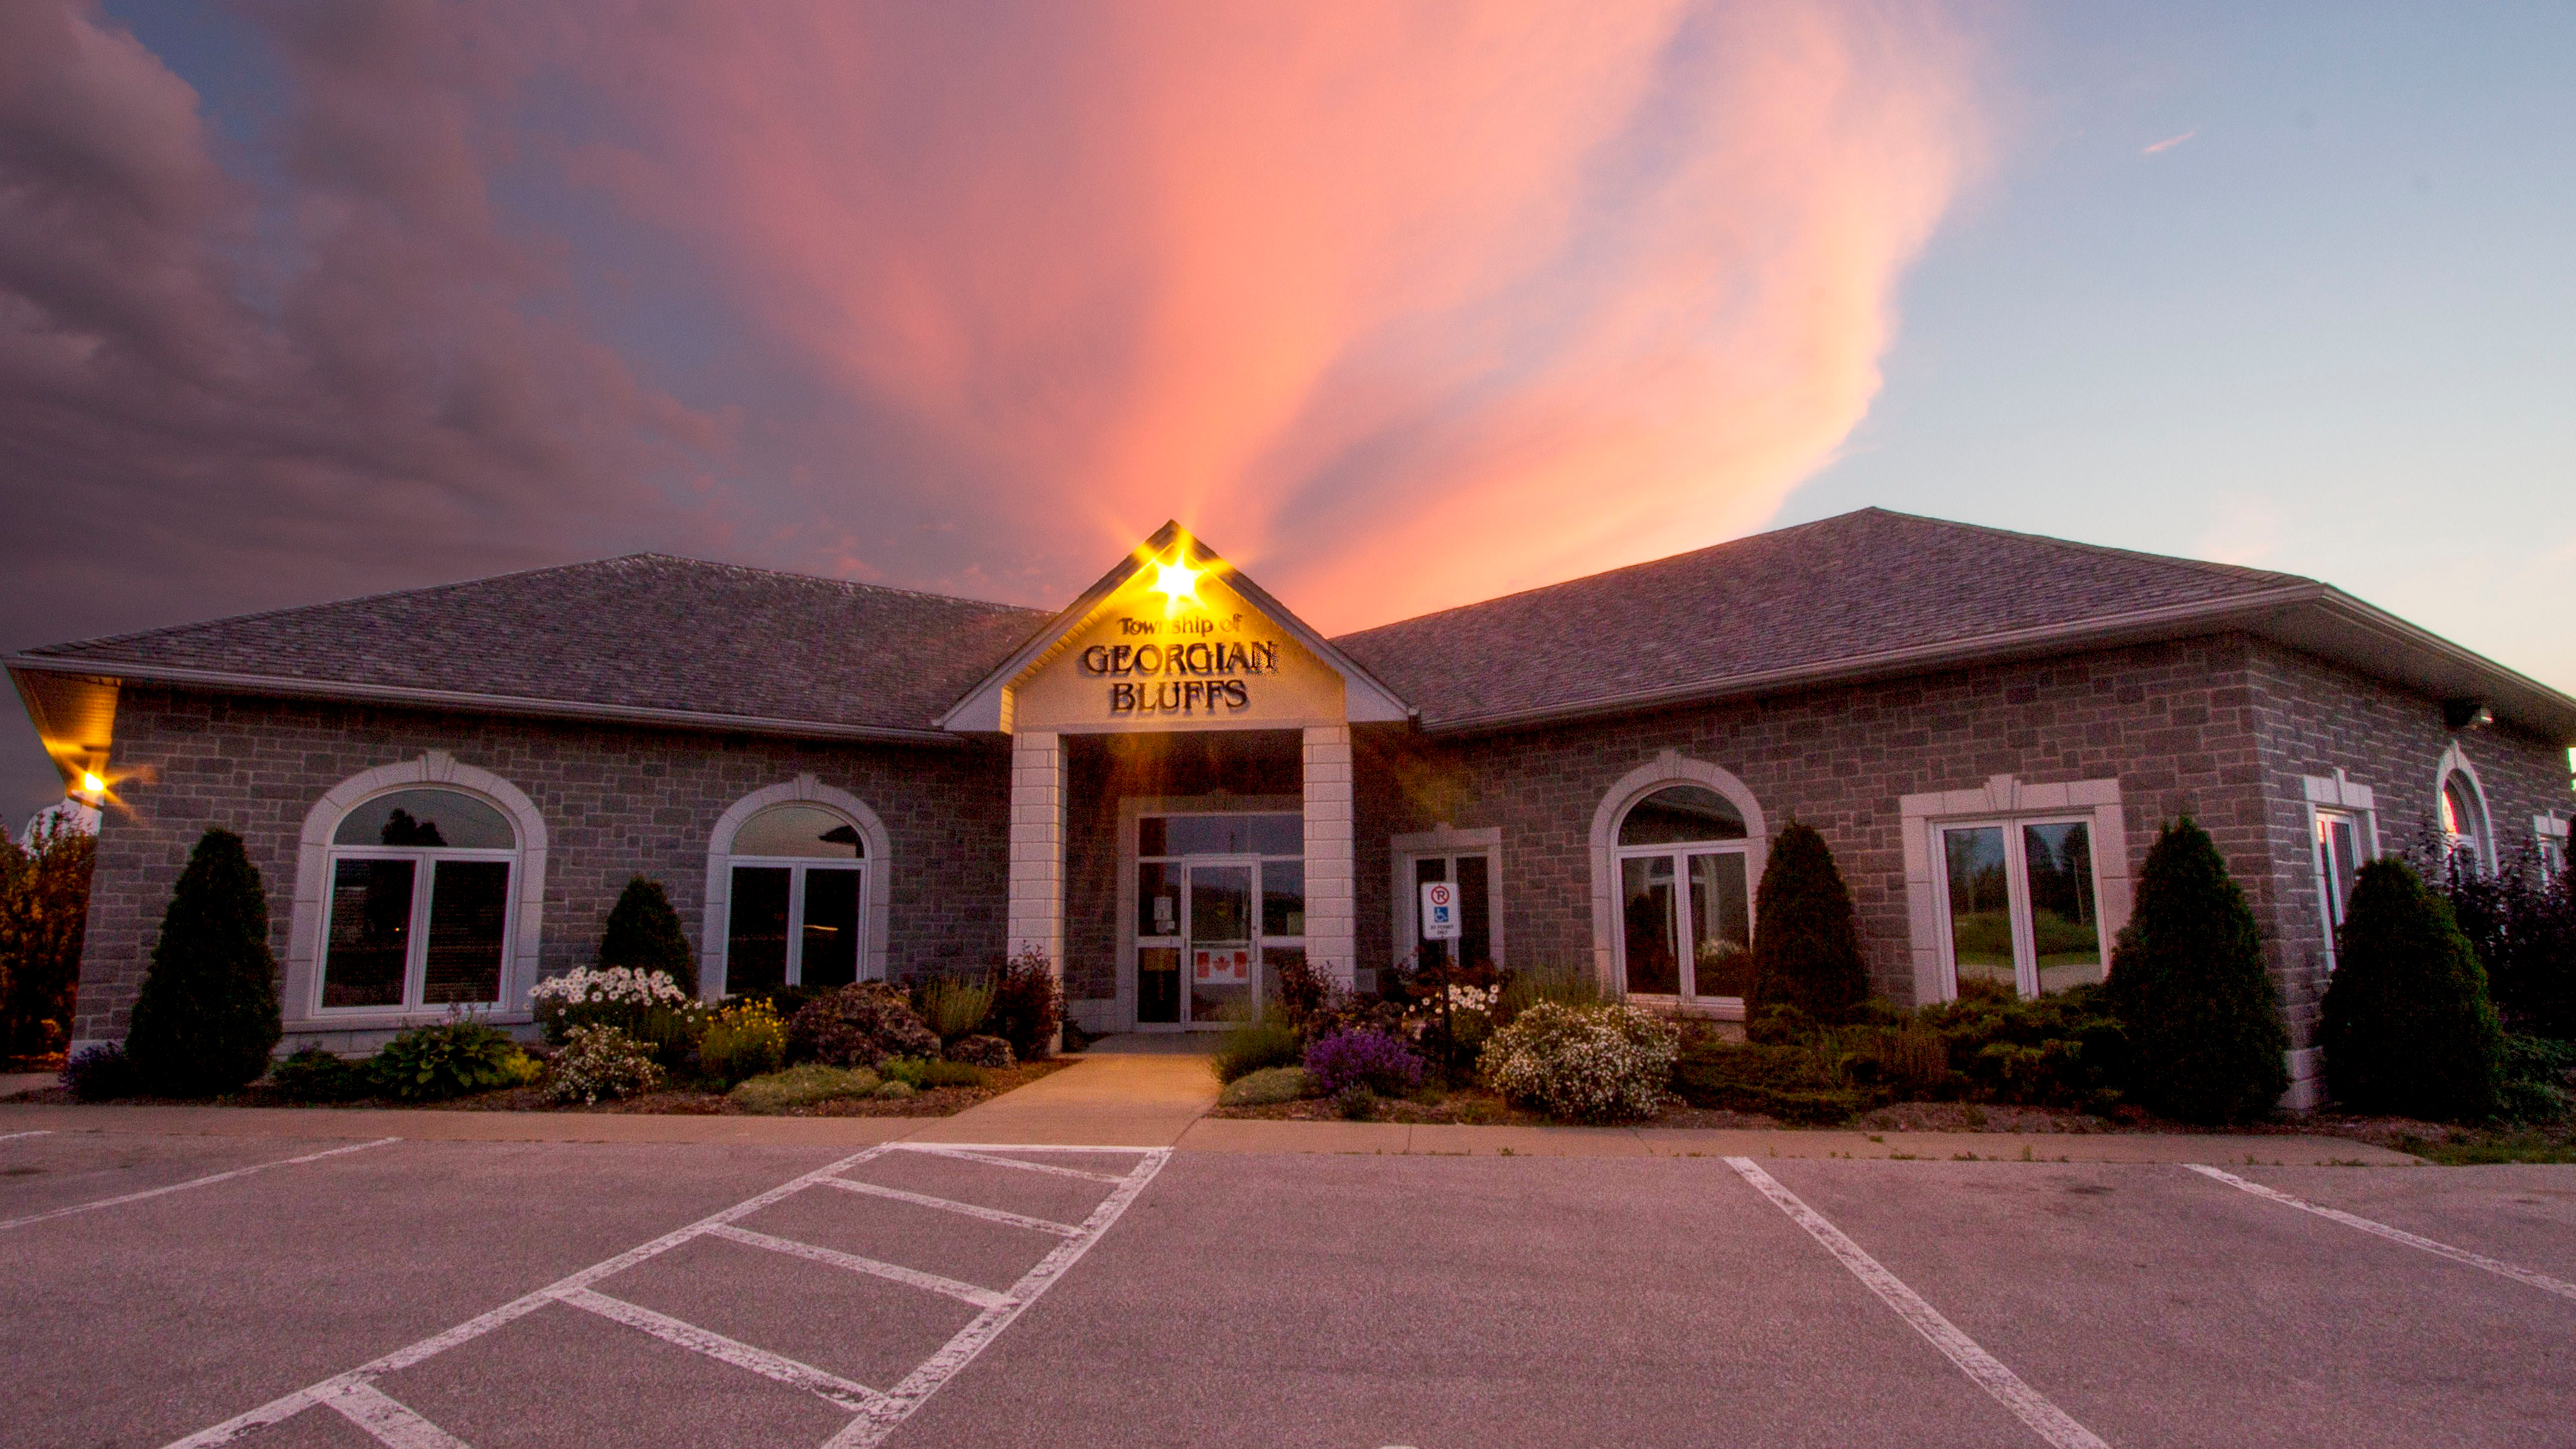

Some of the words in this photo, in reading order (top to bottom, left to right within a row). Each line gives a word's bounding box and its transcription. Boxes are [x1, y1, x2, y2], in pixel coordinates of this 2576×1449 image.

[1219, 613, 1242, 631] of
[1083, 641, 1274, 675] GEORGIAN
[1112, 680, 1247, 711] BLUFFS
